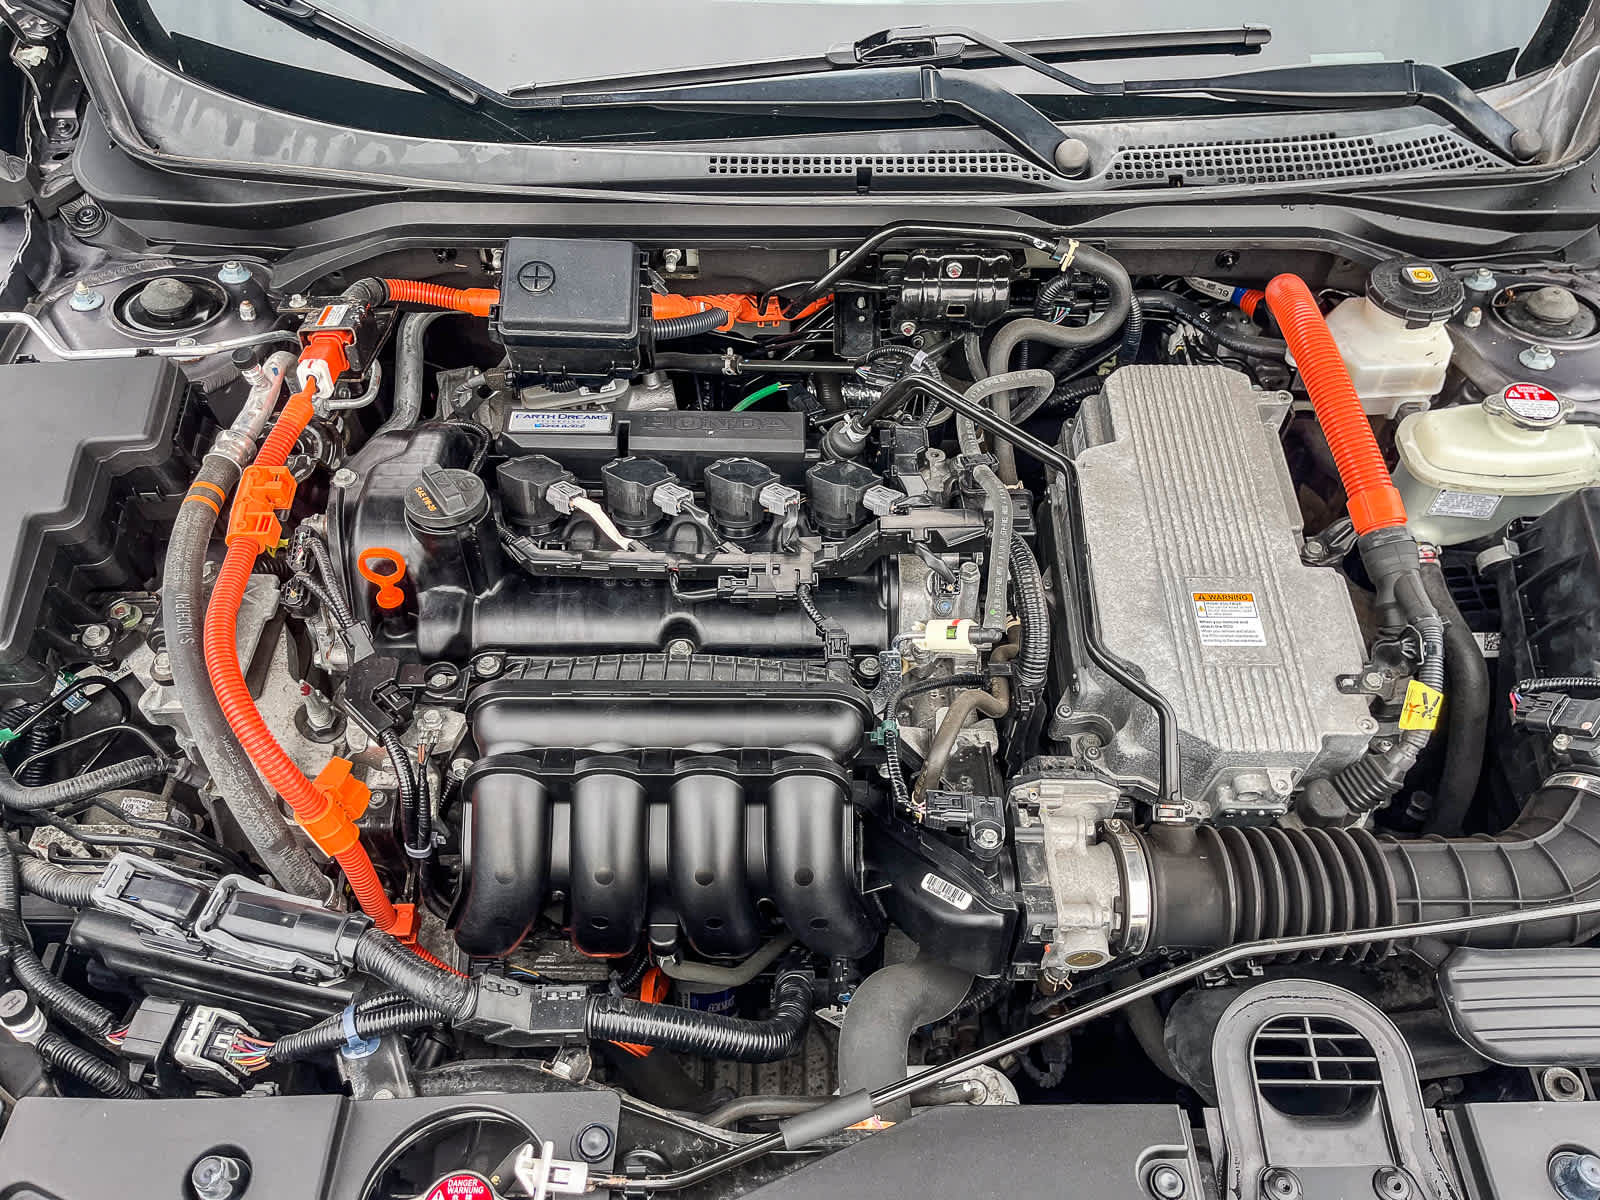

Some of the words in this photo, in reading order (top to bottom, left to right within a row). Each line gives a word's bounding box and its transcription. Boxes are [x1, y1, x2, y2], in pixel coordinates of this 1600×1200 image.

[640, 415, 793, 432] HONDA
[448, 1179, 478, 1187] DANGER
[447, 1186, 484, 1194] WARNUNG
